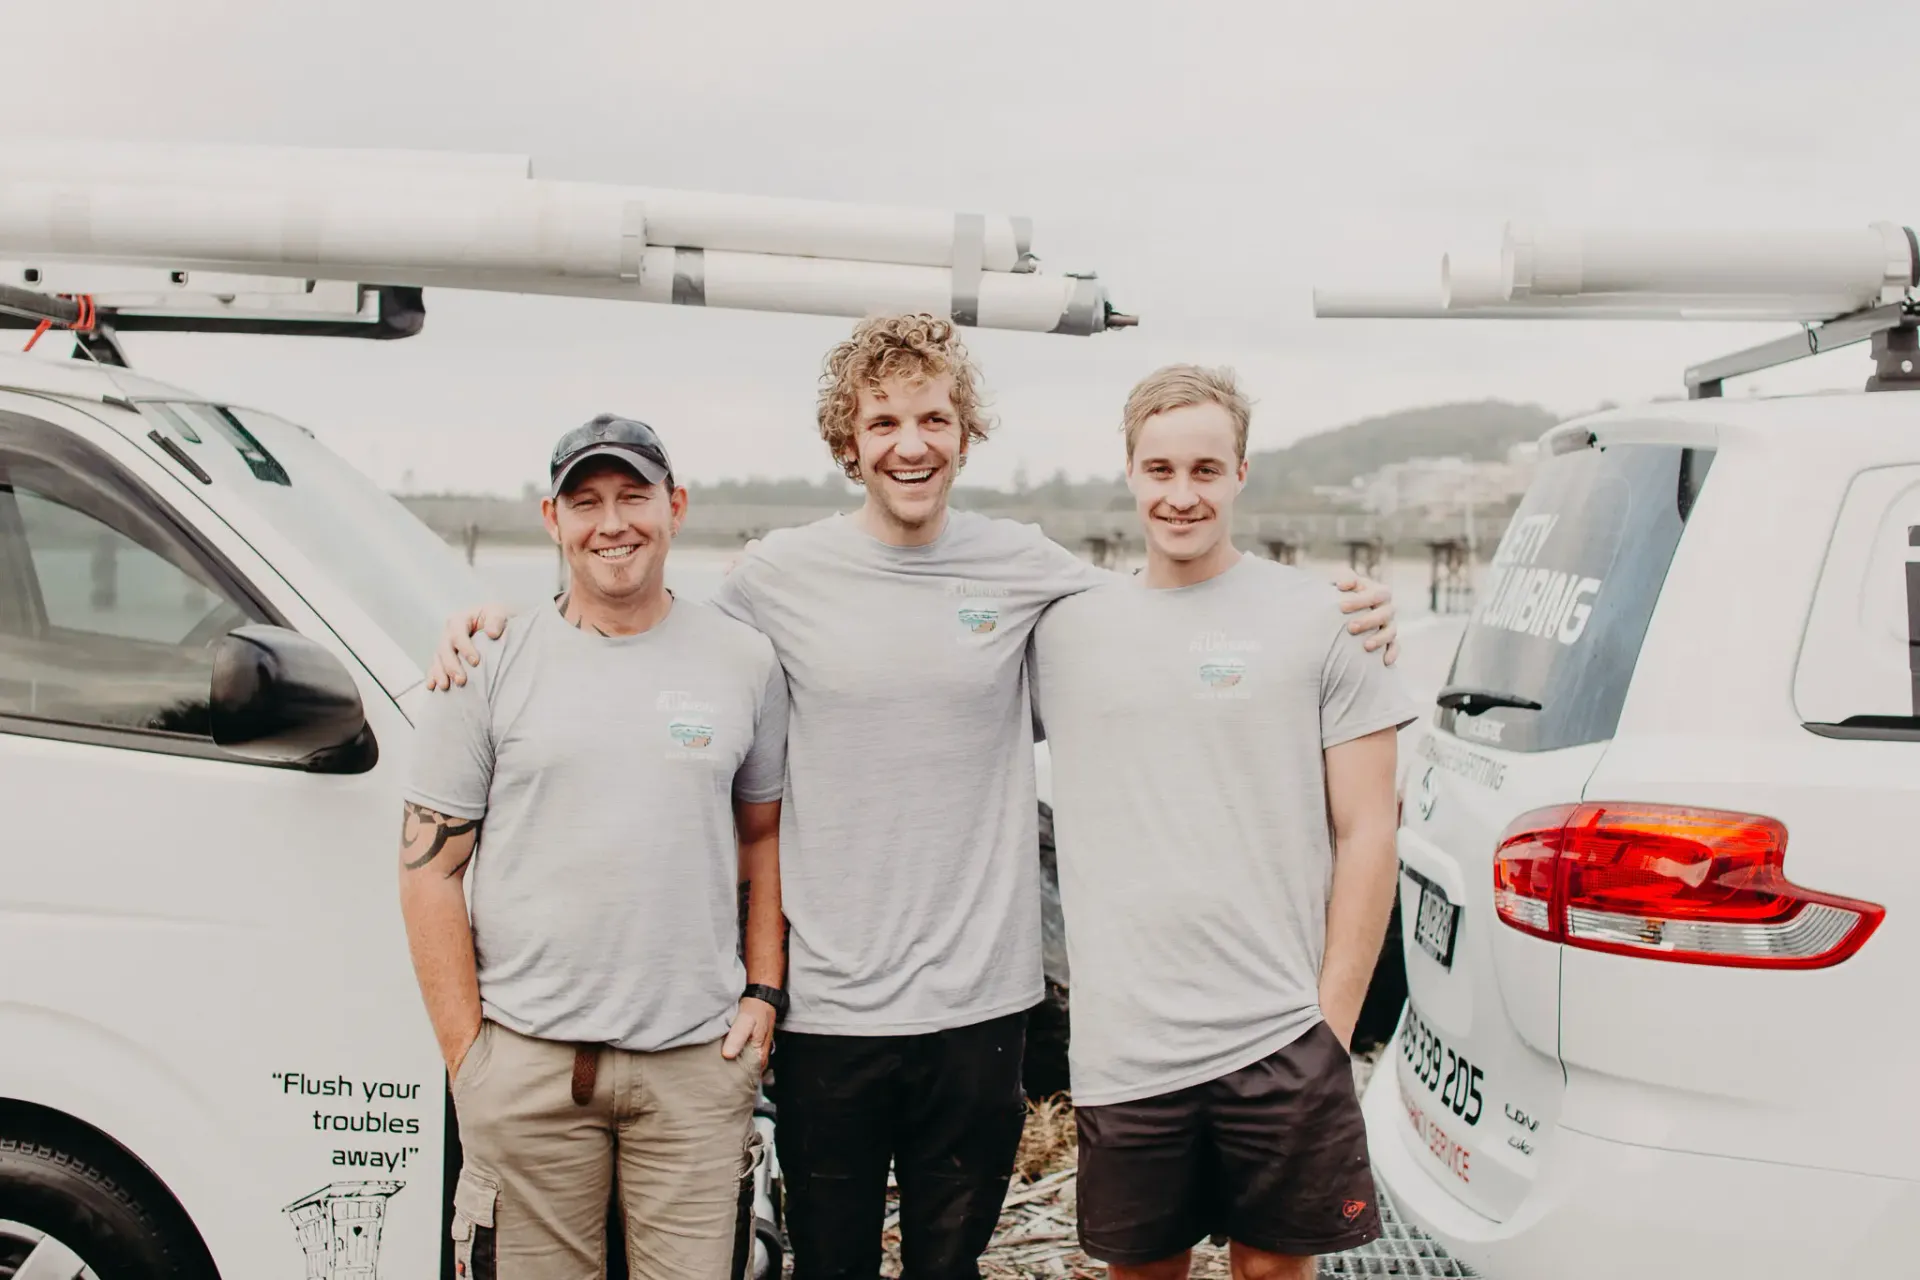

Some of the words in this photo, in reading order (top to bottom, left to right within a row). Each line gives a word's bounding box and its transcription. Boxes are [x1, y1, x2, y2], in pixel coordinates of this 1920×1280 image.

[1480, 565, 1602, 645] UMBING
[362, 1081, 421, 1103] your
[1441, 1045, 1485, 1127] 205
[313, 1110, 420, 1134] troubles
[1504, 1102, 1540, 1133] LDV
